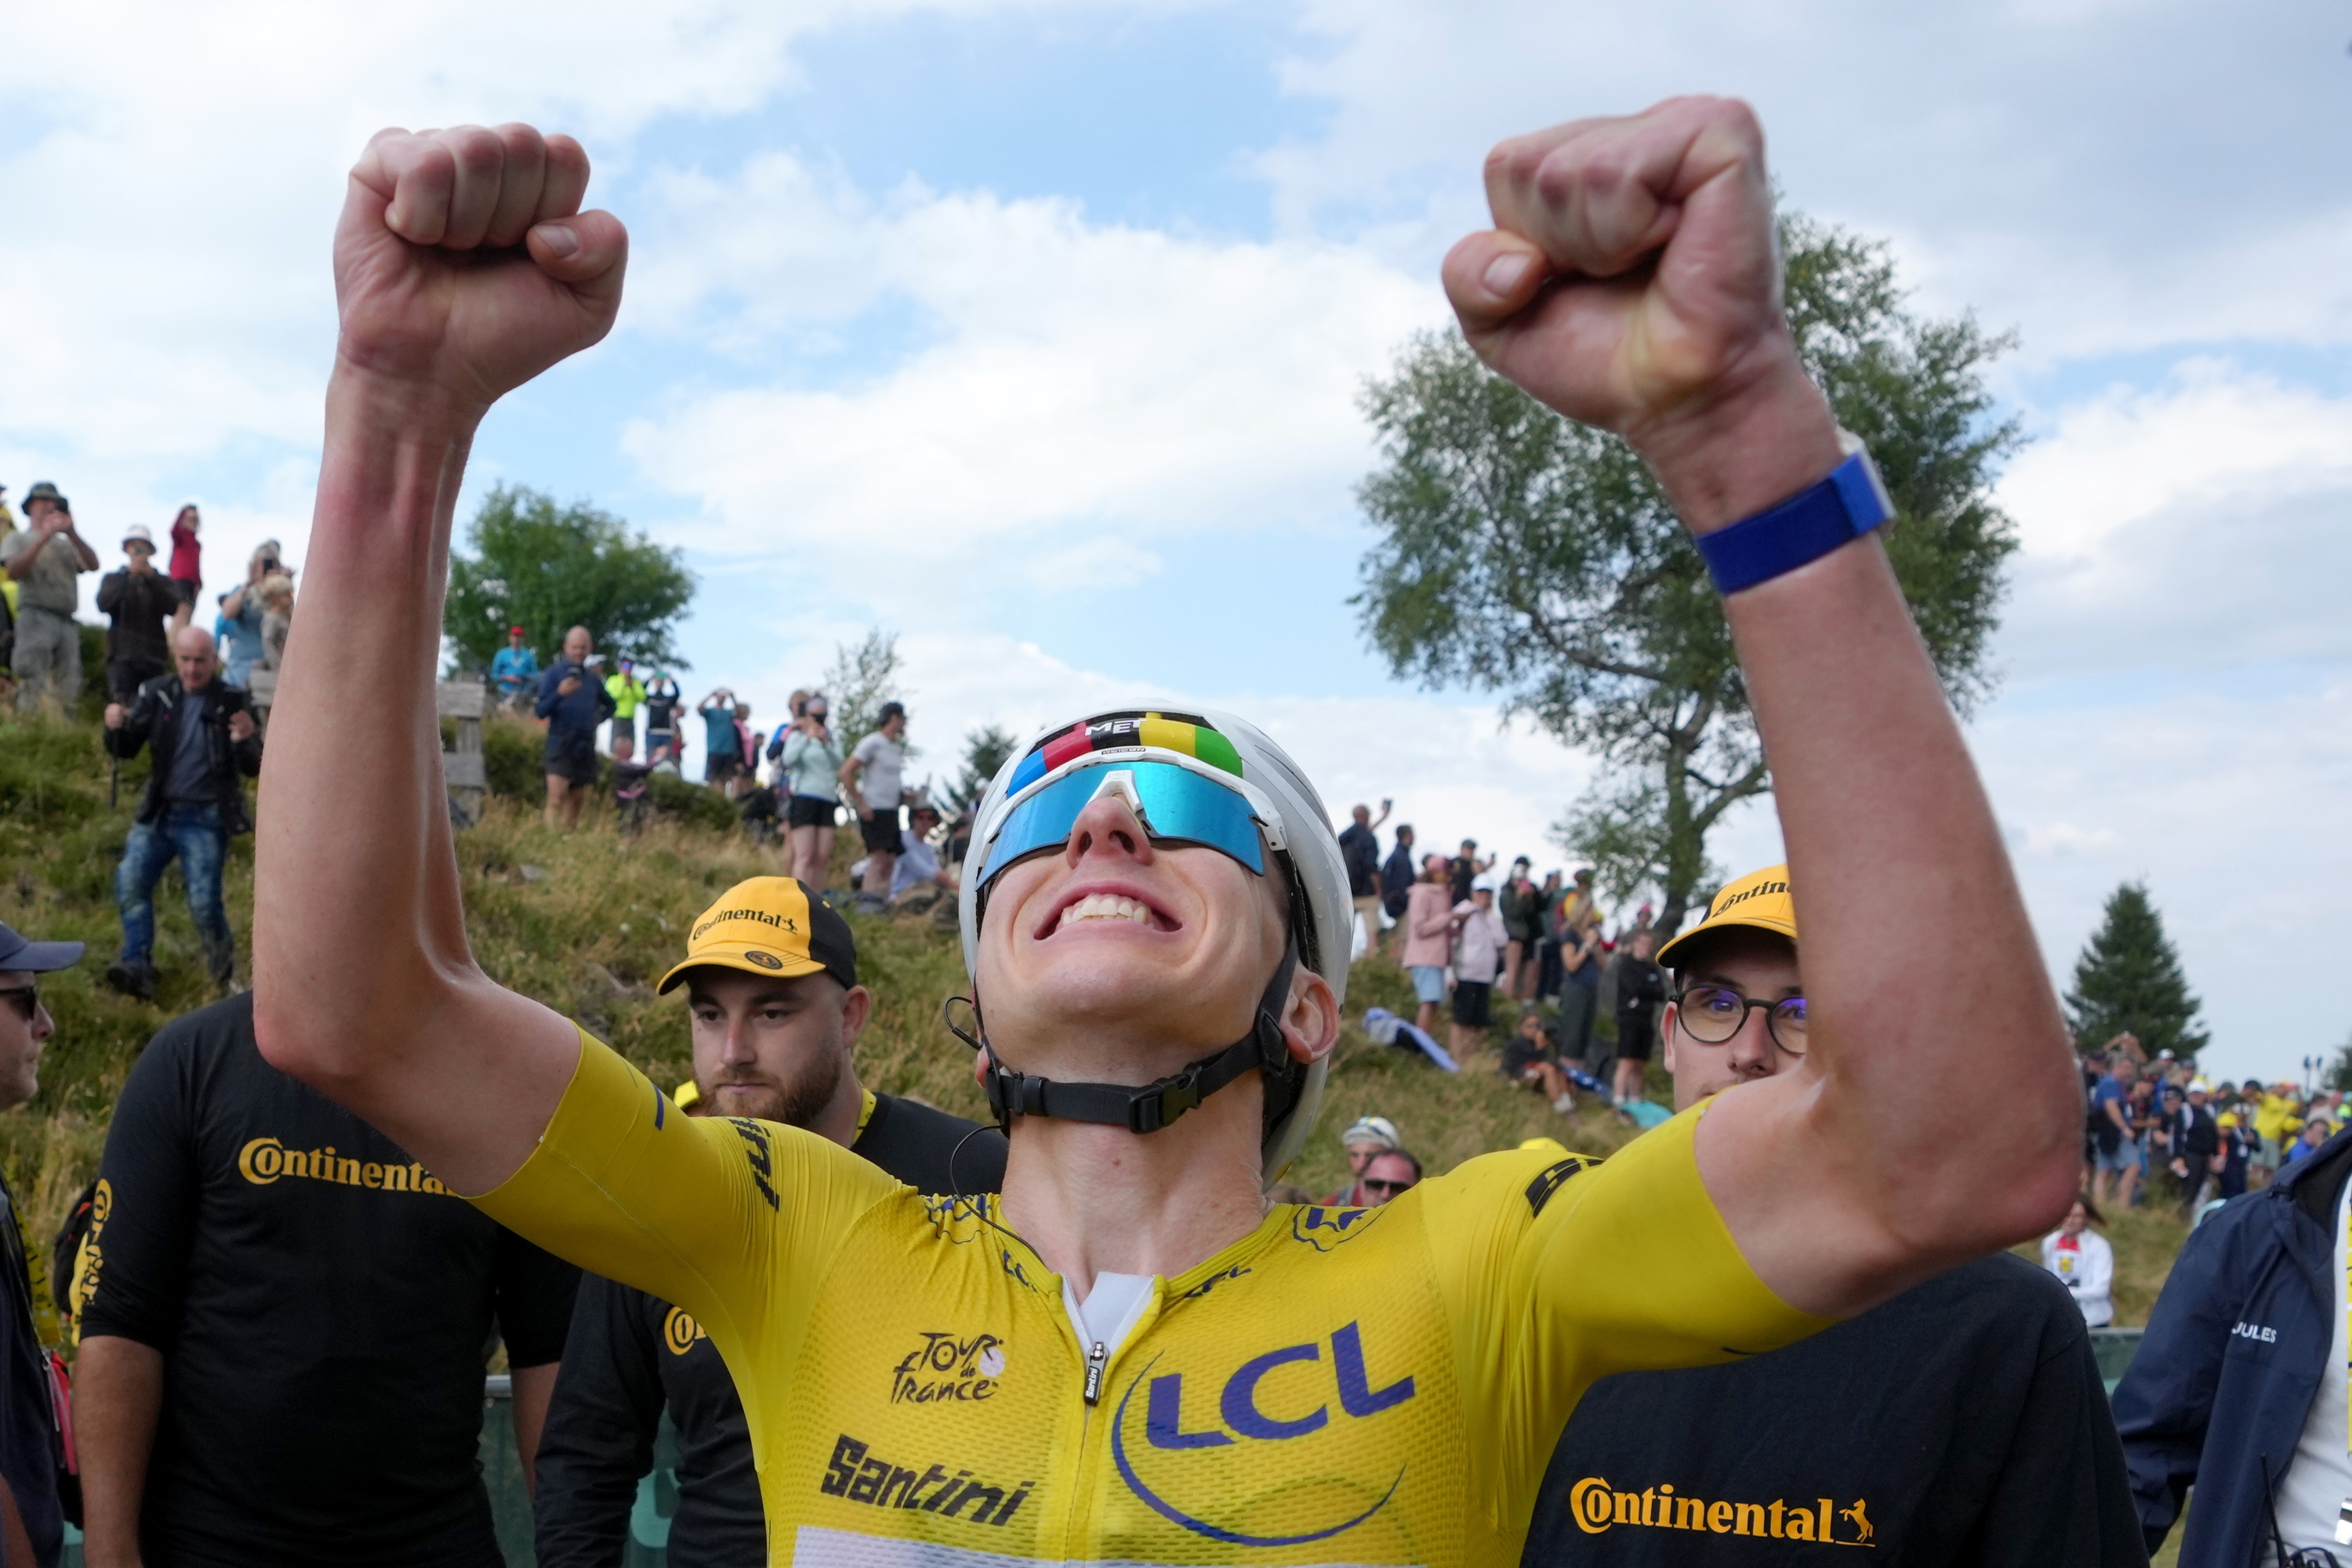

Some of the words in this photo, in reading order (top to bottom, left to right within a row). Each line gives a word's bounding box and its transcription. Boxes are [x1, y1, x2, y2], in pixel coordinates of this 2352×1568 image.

[1085, 719, 1148, 736] MET
[1712, 881, 1792, 918] Contin
[238, 1137, 460, 1197] Continenta
[2231, 1321, 2277, 1343] JULES
[960, 1362, 976, 1377] de
[1085, 1367, 1098, 1399] Santini
[1146, 1320, 1415, 1450] LCL
[821, 1433, 1036, 1526] Santini
[1570, 1477, 1835, 1543] Continental
